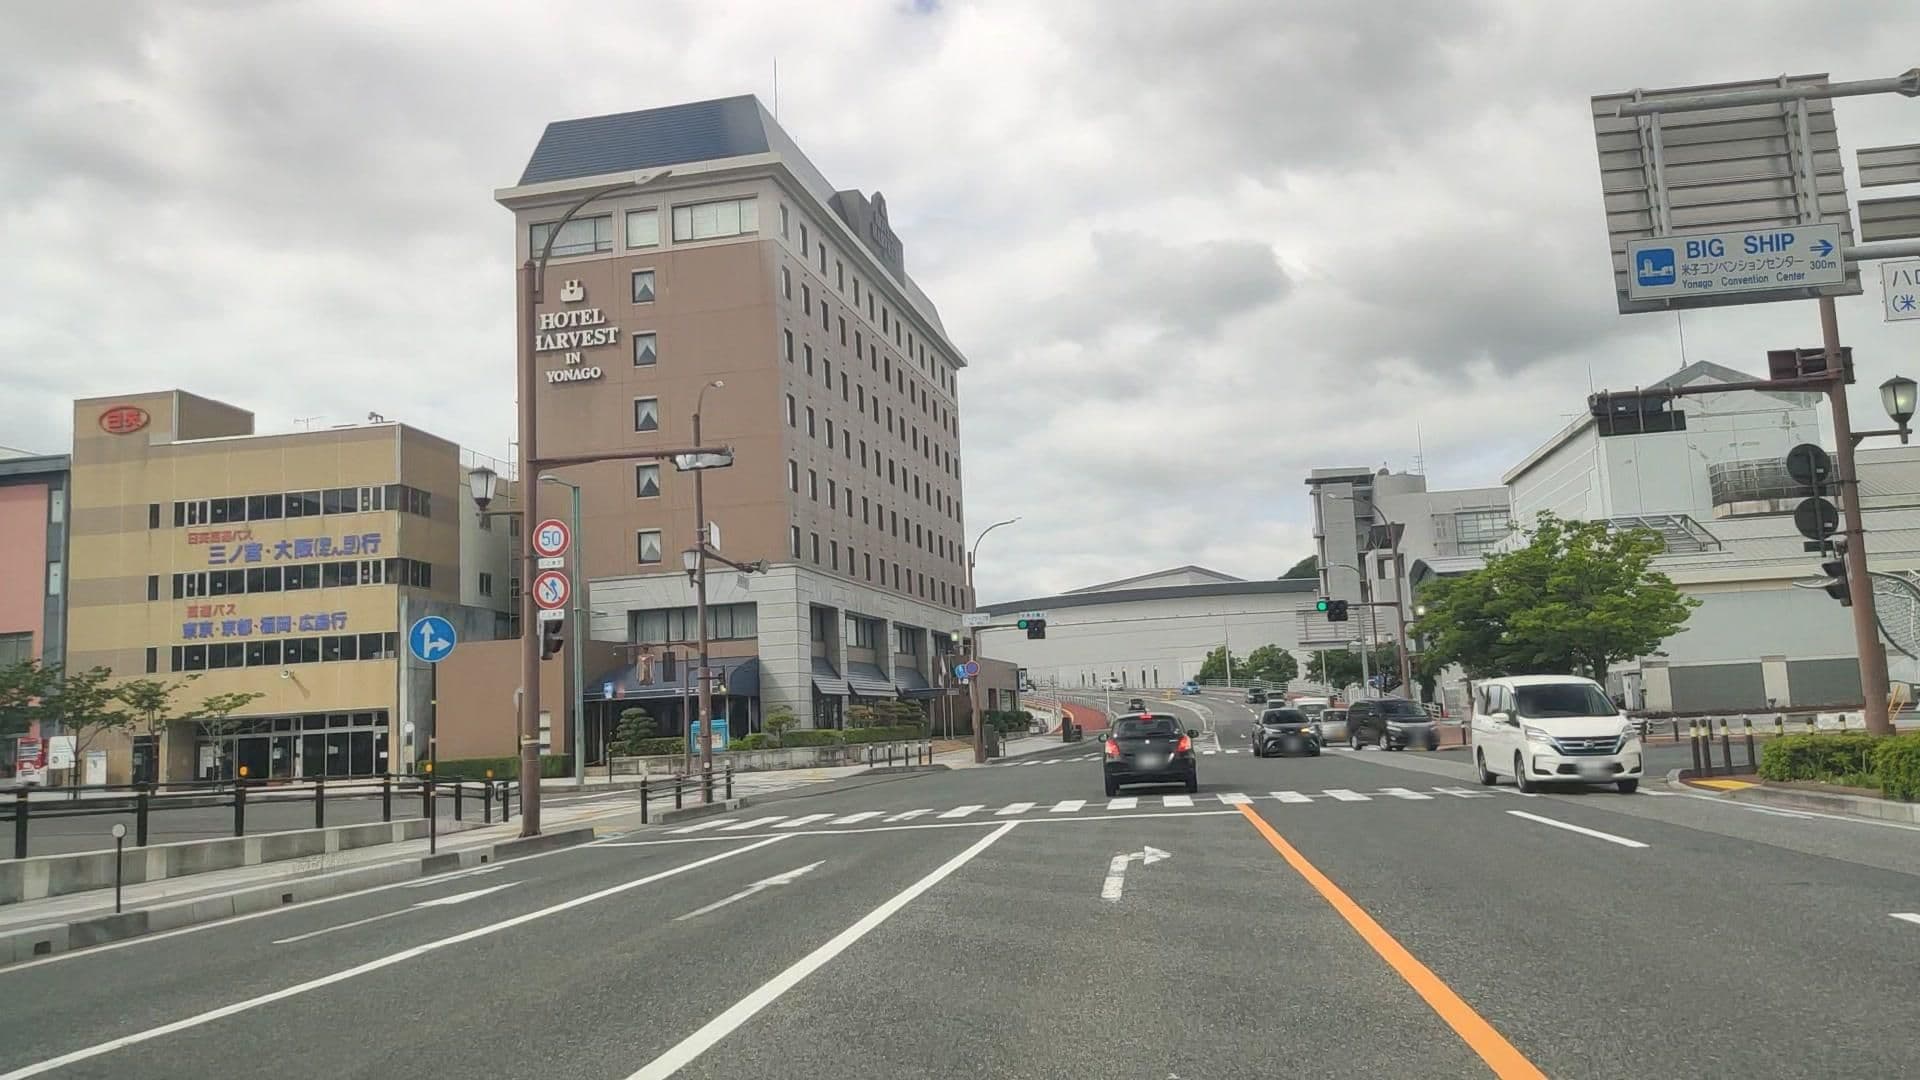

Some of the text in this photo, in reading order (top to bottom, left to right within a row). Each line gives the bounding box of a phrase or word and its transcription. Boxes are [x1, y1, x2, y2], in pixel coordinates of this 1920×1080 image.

[1686, 232, 1795, 259] BIG SHIP
[1681, 255, 1804, 276] 米子コンベンションセンター
[1809, 259, 1837, 271] 300m
[1681, 271, 1806, 290] Yonago Convention Center
[540, 308, 605, 330] HOTEL
[565, 351, 581, 365] IN
[546, 366, 601, 383] YONAGO
[542, 530, 561, 546] 50
